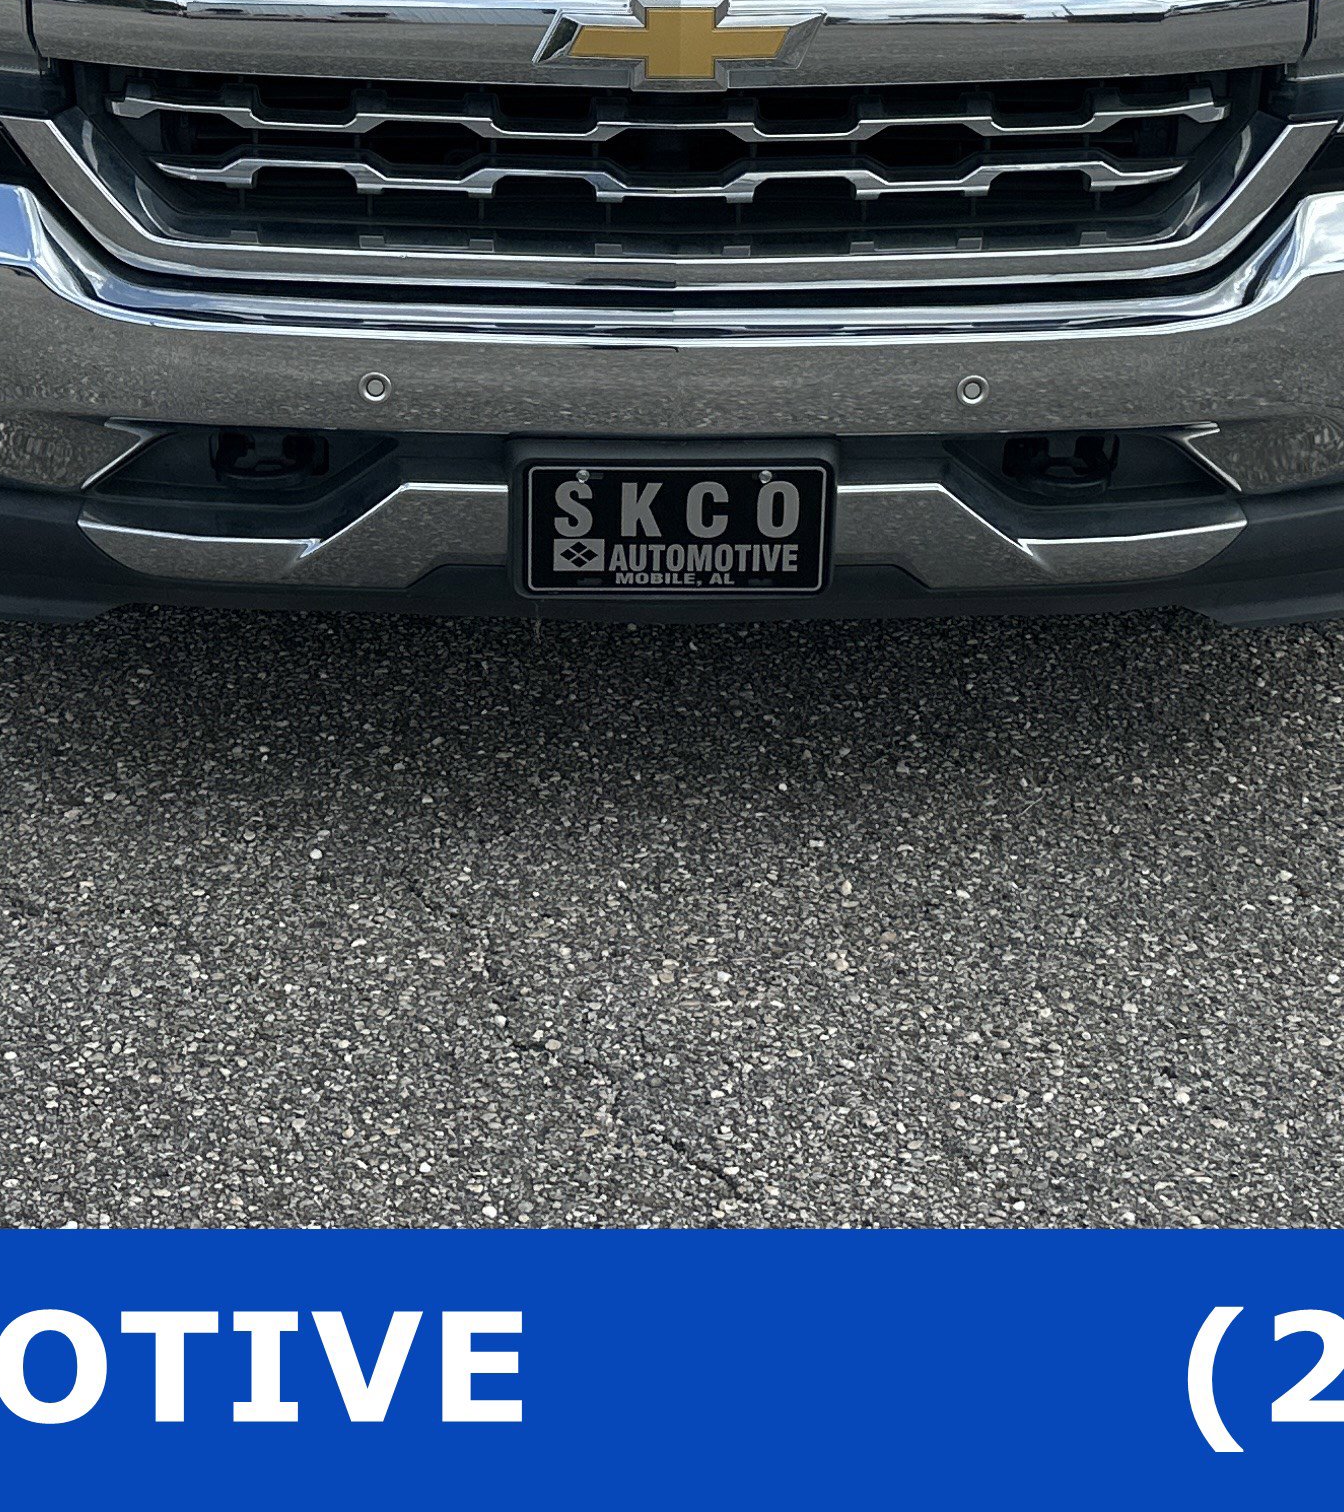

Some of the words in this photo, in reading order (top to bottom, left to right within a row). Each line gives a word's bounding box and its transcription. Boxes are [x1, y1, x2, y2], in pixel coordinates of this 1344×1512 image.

[608, 544, 799, 572] AUTOMOTIVE
[615, 572, 702, 586] MOBILE,
[708, 572, 735, 585] AL
